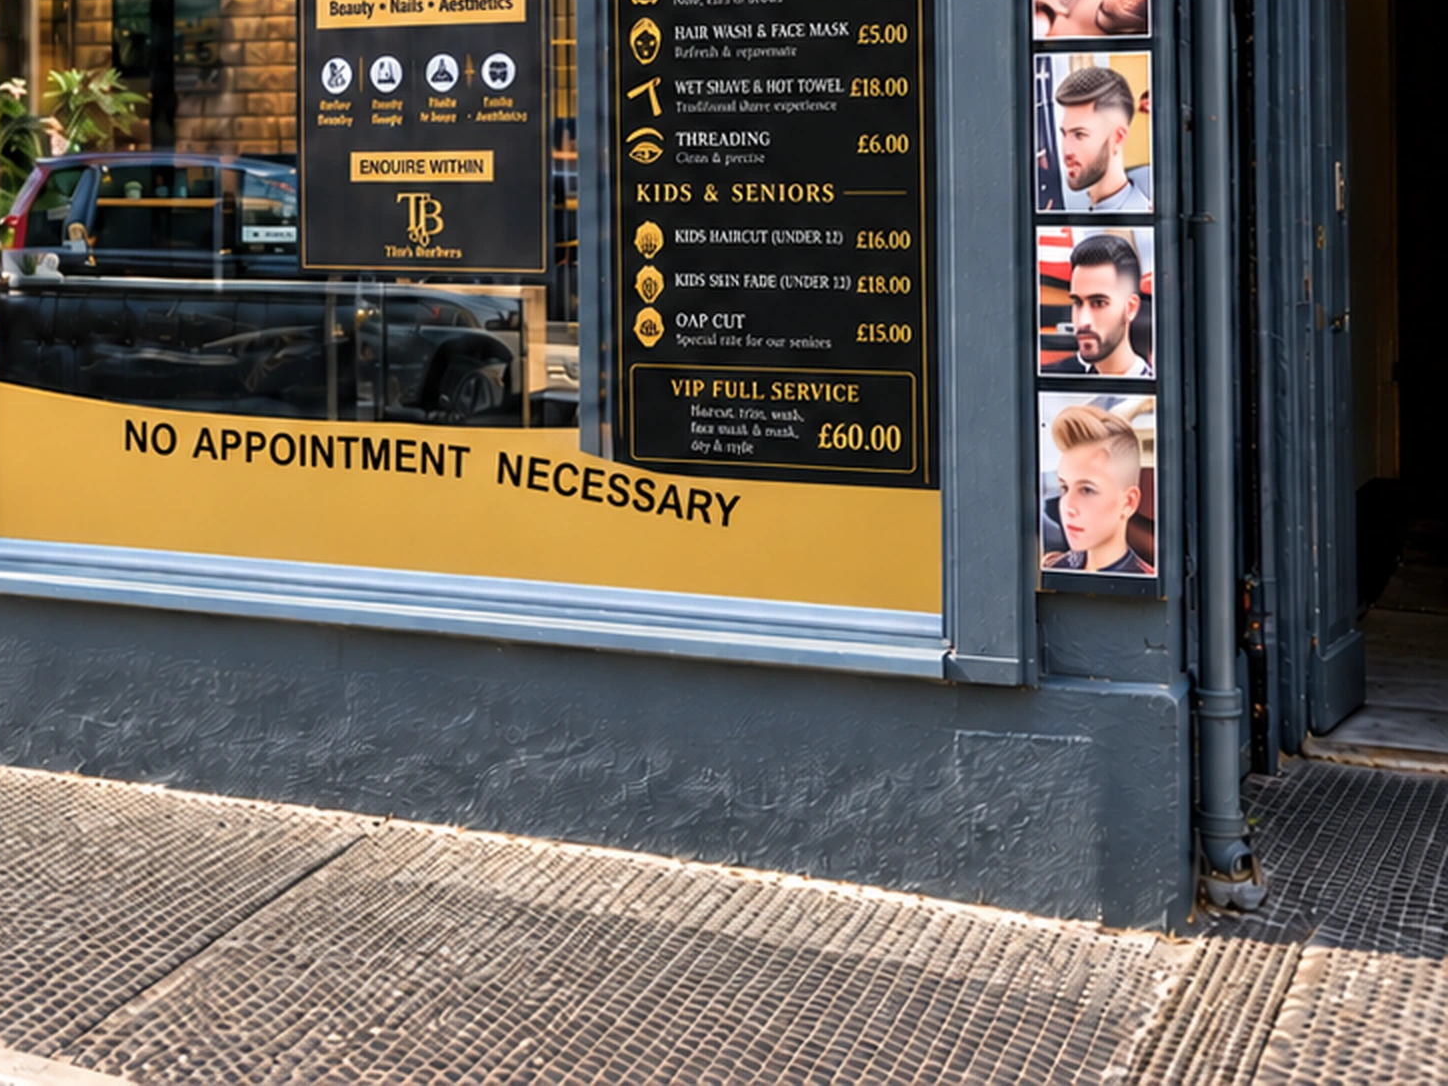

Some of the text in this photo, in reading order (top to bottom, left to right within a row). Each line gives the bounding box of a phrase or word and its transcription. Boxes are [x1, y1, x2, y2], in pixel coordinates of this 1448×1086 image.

[675, 21, 908, 45] HAIR WASH & FACE MASK £5.00
[674, 77, 909, 98] WET SHAVE & HOT TOWEL £18.00
[675, 131, 909, 154] THREADING £6.00
[429, 159, 483, 174] WITHIN
[636, 183, 835, 203] KIDS & SENIORS
[675, 229, 707, 244] KIDS
[709, 229, 769, 244] HAIRCUT
[771, 229, 823, 246] (UNDER
[856, 230, 911, 250] £16.00
[675, 273, 706, 288] KIDS
[743, 273, 777, 289] FADE
[779, 274, 830, 291] (UNDER
[856, 275, 912, 295] £18.00
[675, 312, 747, 329] OAP CUT
[855, 323, 912, 343] £15.00
[670, 379, 861, 403] VIP FULL SERVICE
[818, 422, 902, 452] £60.00
[123, 419, 741, 530] NO APPOINTMENT NECESSARY
